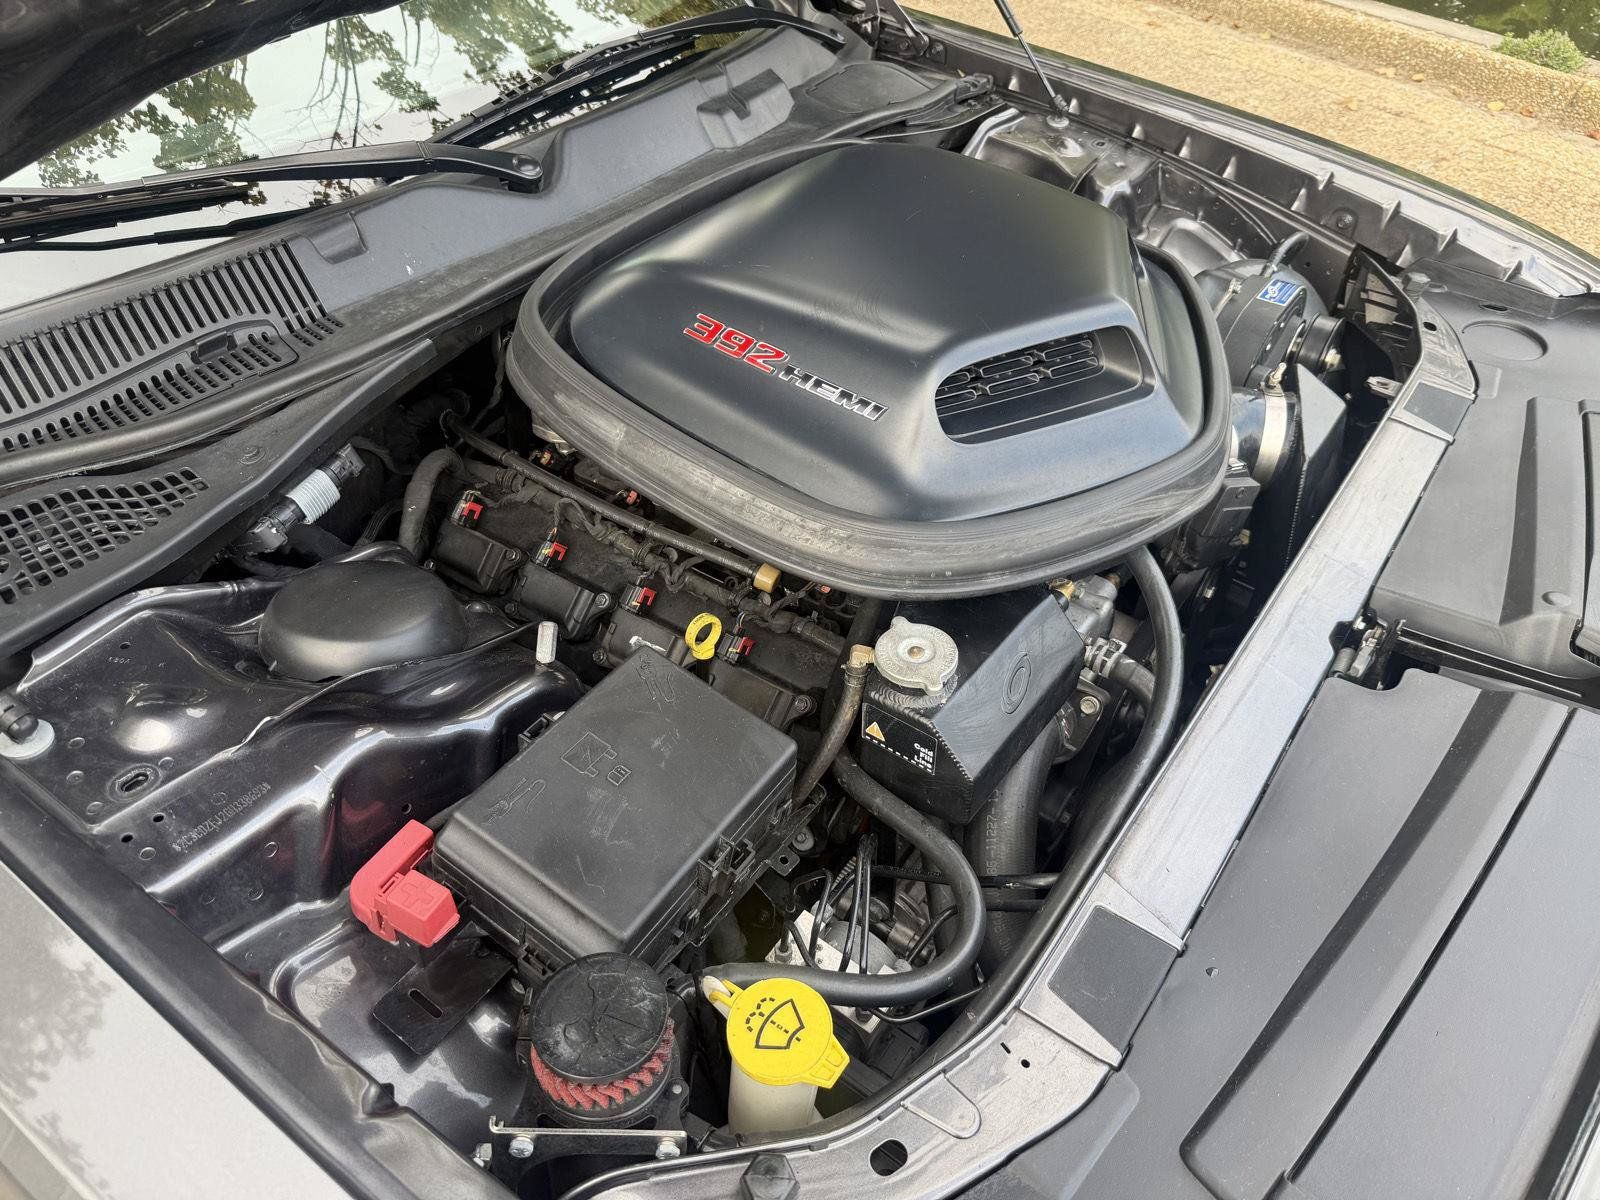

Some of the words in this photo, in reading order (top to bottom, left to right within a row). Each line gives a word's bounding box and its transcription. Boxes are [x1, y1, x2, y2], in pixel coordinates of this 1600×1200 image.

[683, 313, 788, 375] 392
[778, 365, 889, 421] HEMI
[913, 742, 933, 758] Cold
[914, 755, 933, 768] Line
[919, 752, 933, 764] Fill
